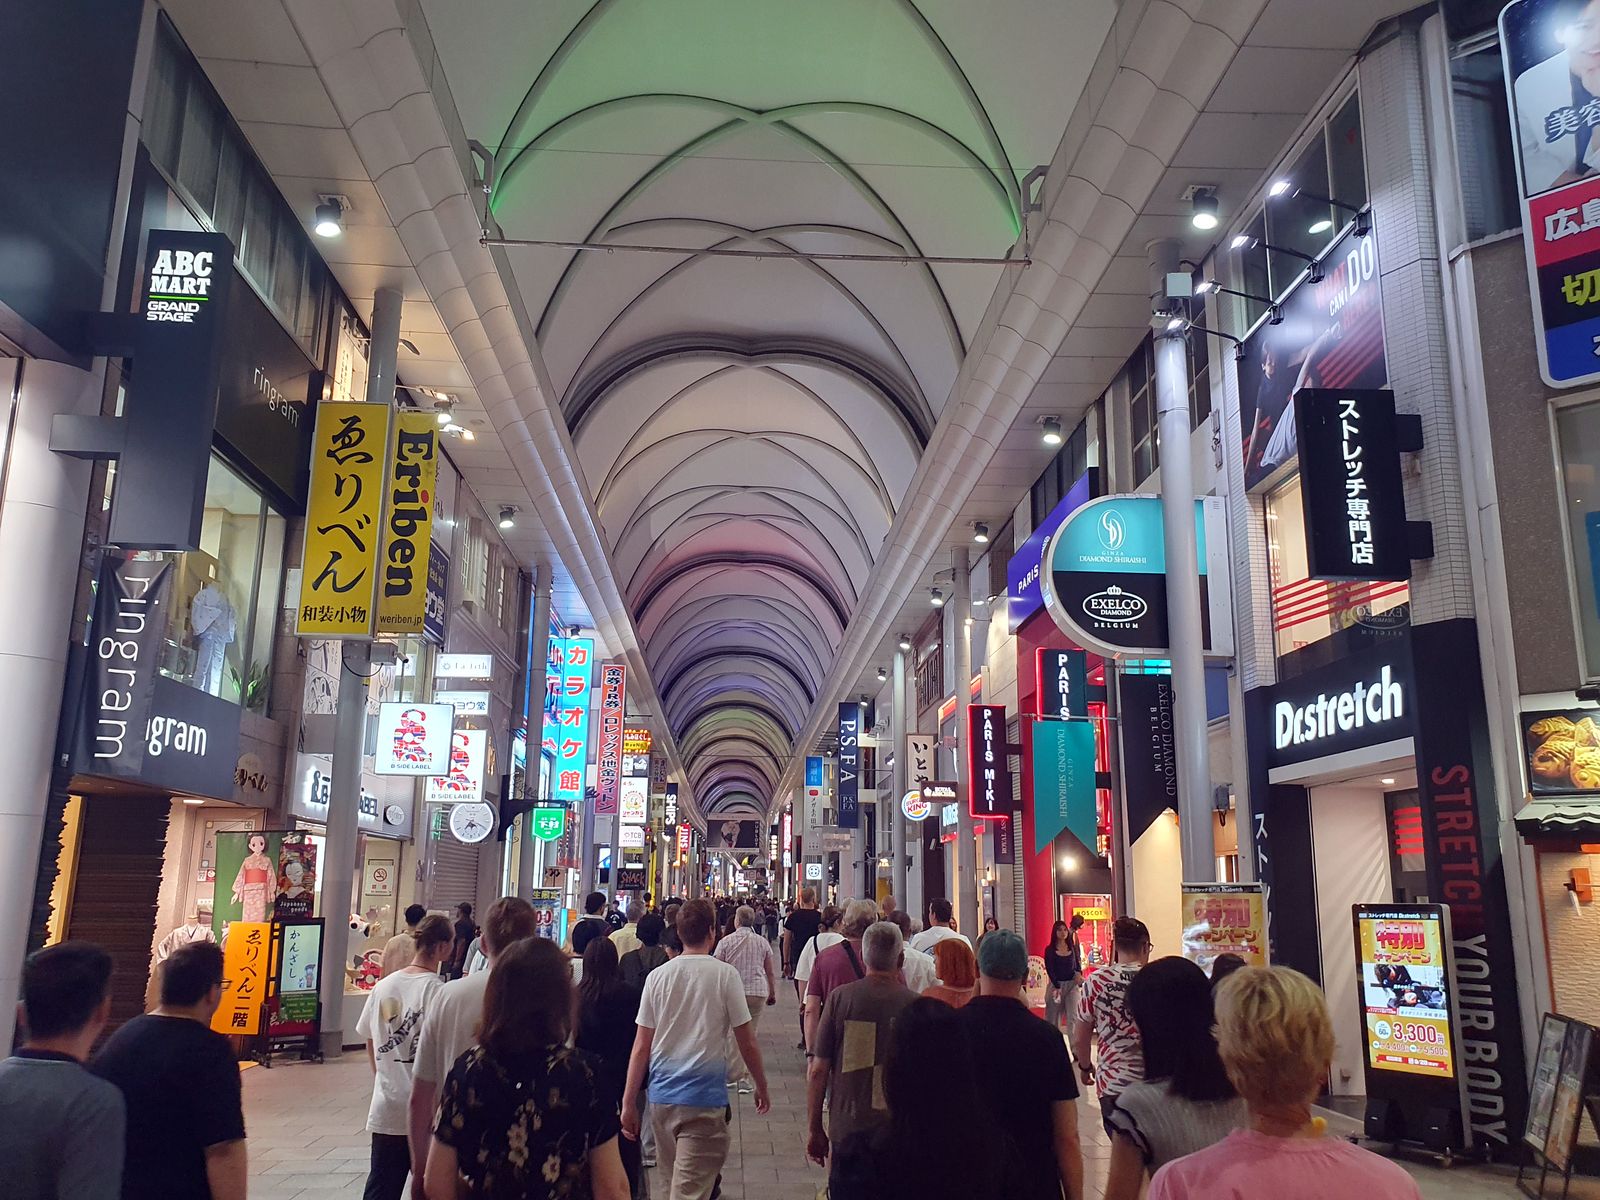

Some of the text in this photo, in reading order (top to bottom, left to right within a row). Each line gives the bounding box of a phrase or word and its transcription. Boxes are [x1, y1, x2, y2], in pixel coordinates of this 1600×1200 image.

[150, 275, 211, 296] MART
[151, 249, 213, 276] ABC
[1347, 235, 1374, 297] DO
[146, 311, 194, 323] STAGE
[147, 300, 200, 314] GRAND
[254, 366, 299, 428] ringram
[312, 414, 374, 595] ゑりべん
[384, 428, 435, 598] Eriben
[1338, 399, 1374, 566] ストレッチ専門店
[1018, 564, 1039, 594] PARIS
[1079, 555, 1147, 564] DIAMOND SHIRAISHI
[301, 605, 367, 624] 和装小物
[379, 614, 422, 626] weriben.jp
[1091, 598, 1141, 610] EXELCO
[94, 575, 160, 759] ringram
[1058, 653, 1071, 721] PARIS
[559, 646, 588, 792] カラオケ館
[1275, 664, 1403, 750] Dr.stretch
[984, 708, 995, 811] PARIS MIKI
[1150, 707, 1162, 773] BELGIUM
[1158, 683, 1176, 796] EXELCO DIAMOND
[1057, 729, 1068, 818] DIAMOND SHIRAISHI
[665, 794, 677, 825] SHIPS
[680, 827, 689, 848] JINS
[906, 802, 928, 813] KING
[288, 929, 301, 978] かんざし
[1373, 951, 1432, 964] キャンペーン
[1375, 922, 1426, 950] 特別
[231, 929, 262, 1028] ゑりべん二階
[1452, 934, 1495, 1036] YOUR
[1464, 1040, 1508, 1145] BODY
